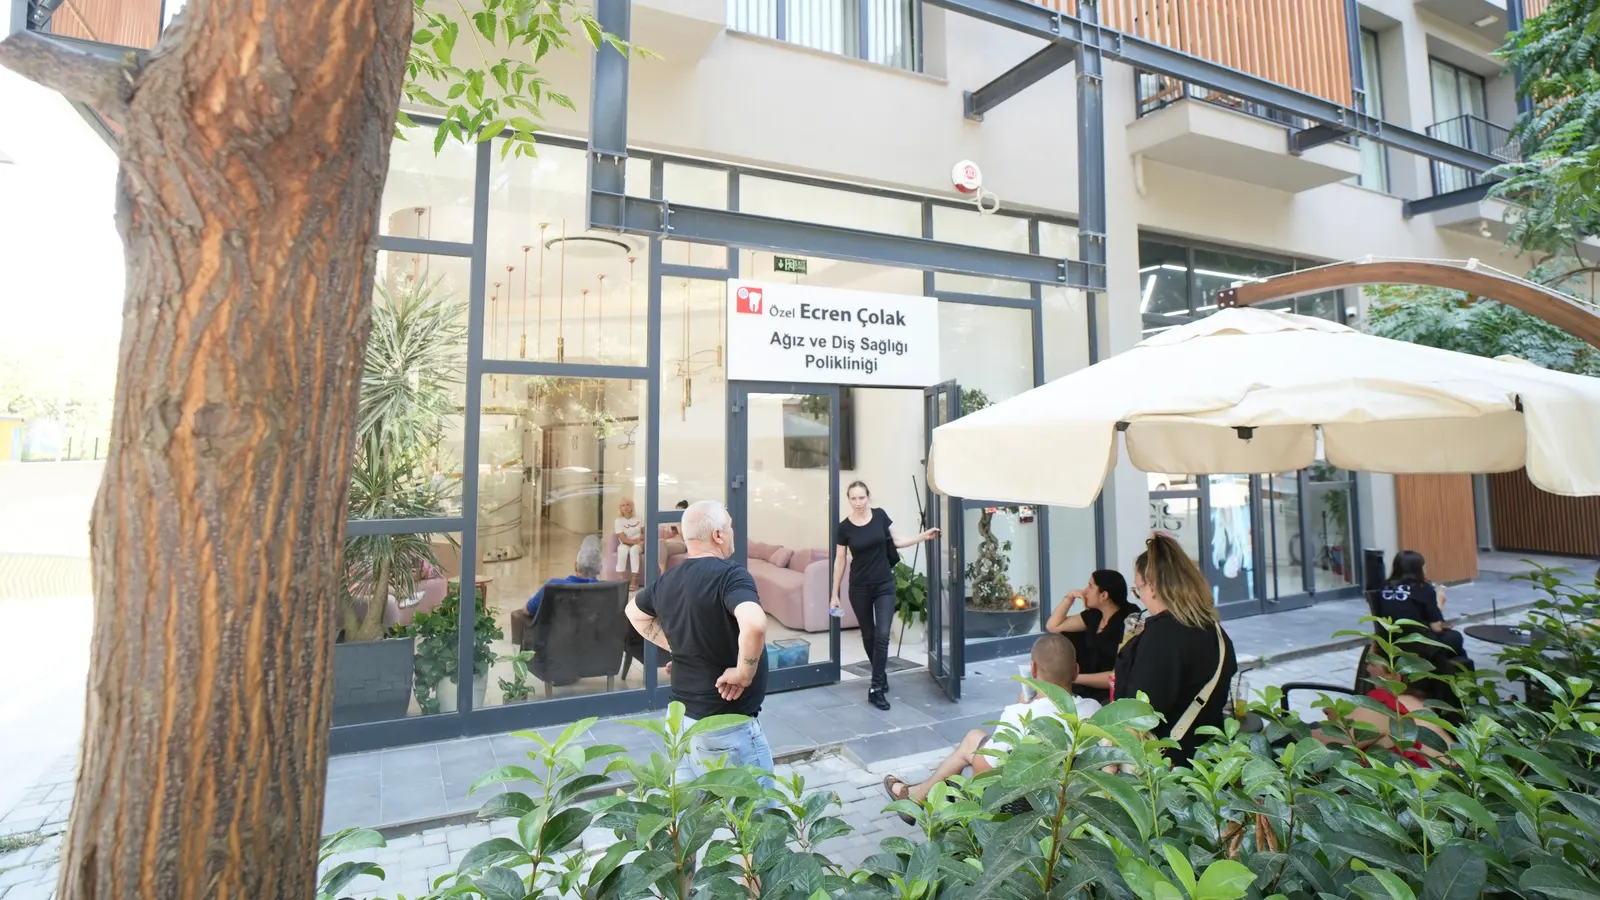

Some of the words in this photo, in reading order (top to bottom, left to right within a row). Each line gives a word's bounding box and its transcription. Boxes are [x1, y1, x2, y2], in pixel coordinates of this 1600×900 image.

[769, 304, 796, 318] Özel
[800, 302, 852, 322] Ecren
[856, 307, 906, 328] Çolak
[769, 331, 805, 350] Ağız
[809, 337, 827, 348] ve
[832, 335, 855, 353] Diş
[860, 337, 908, 356] Sağlığı
[805, 354, 878, 374] Polikliniği
